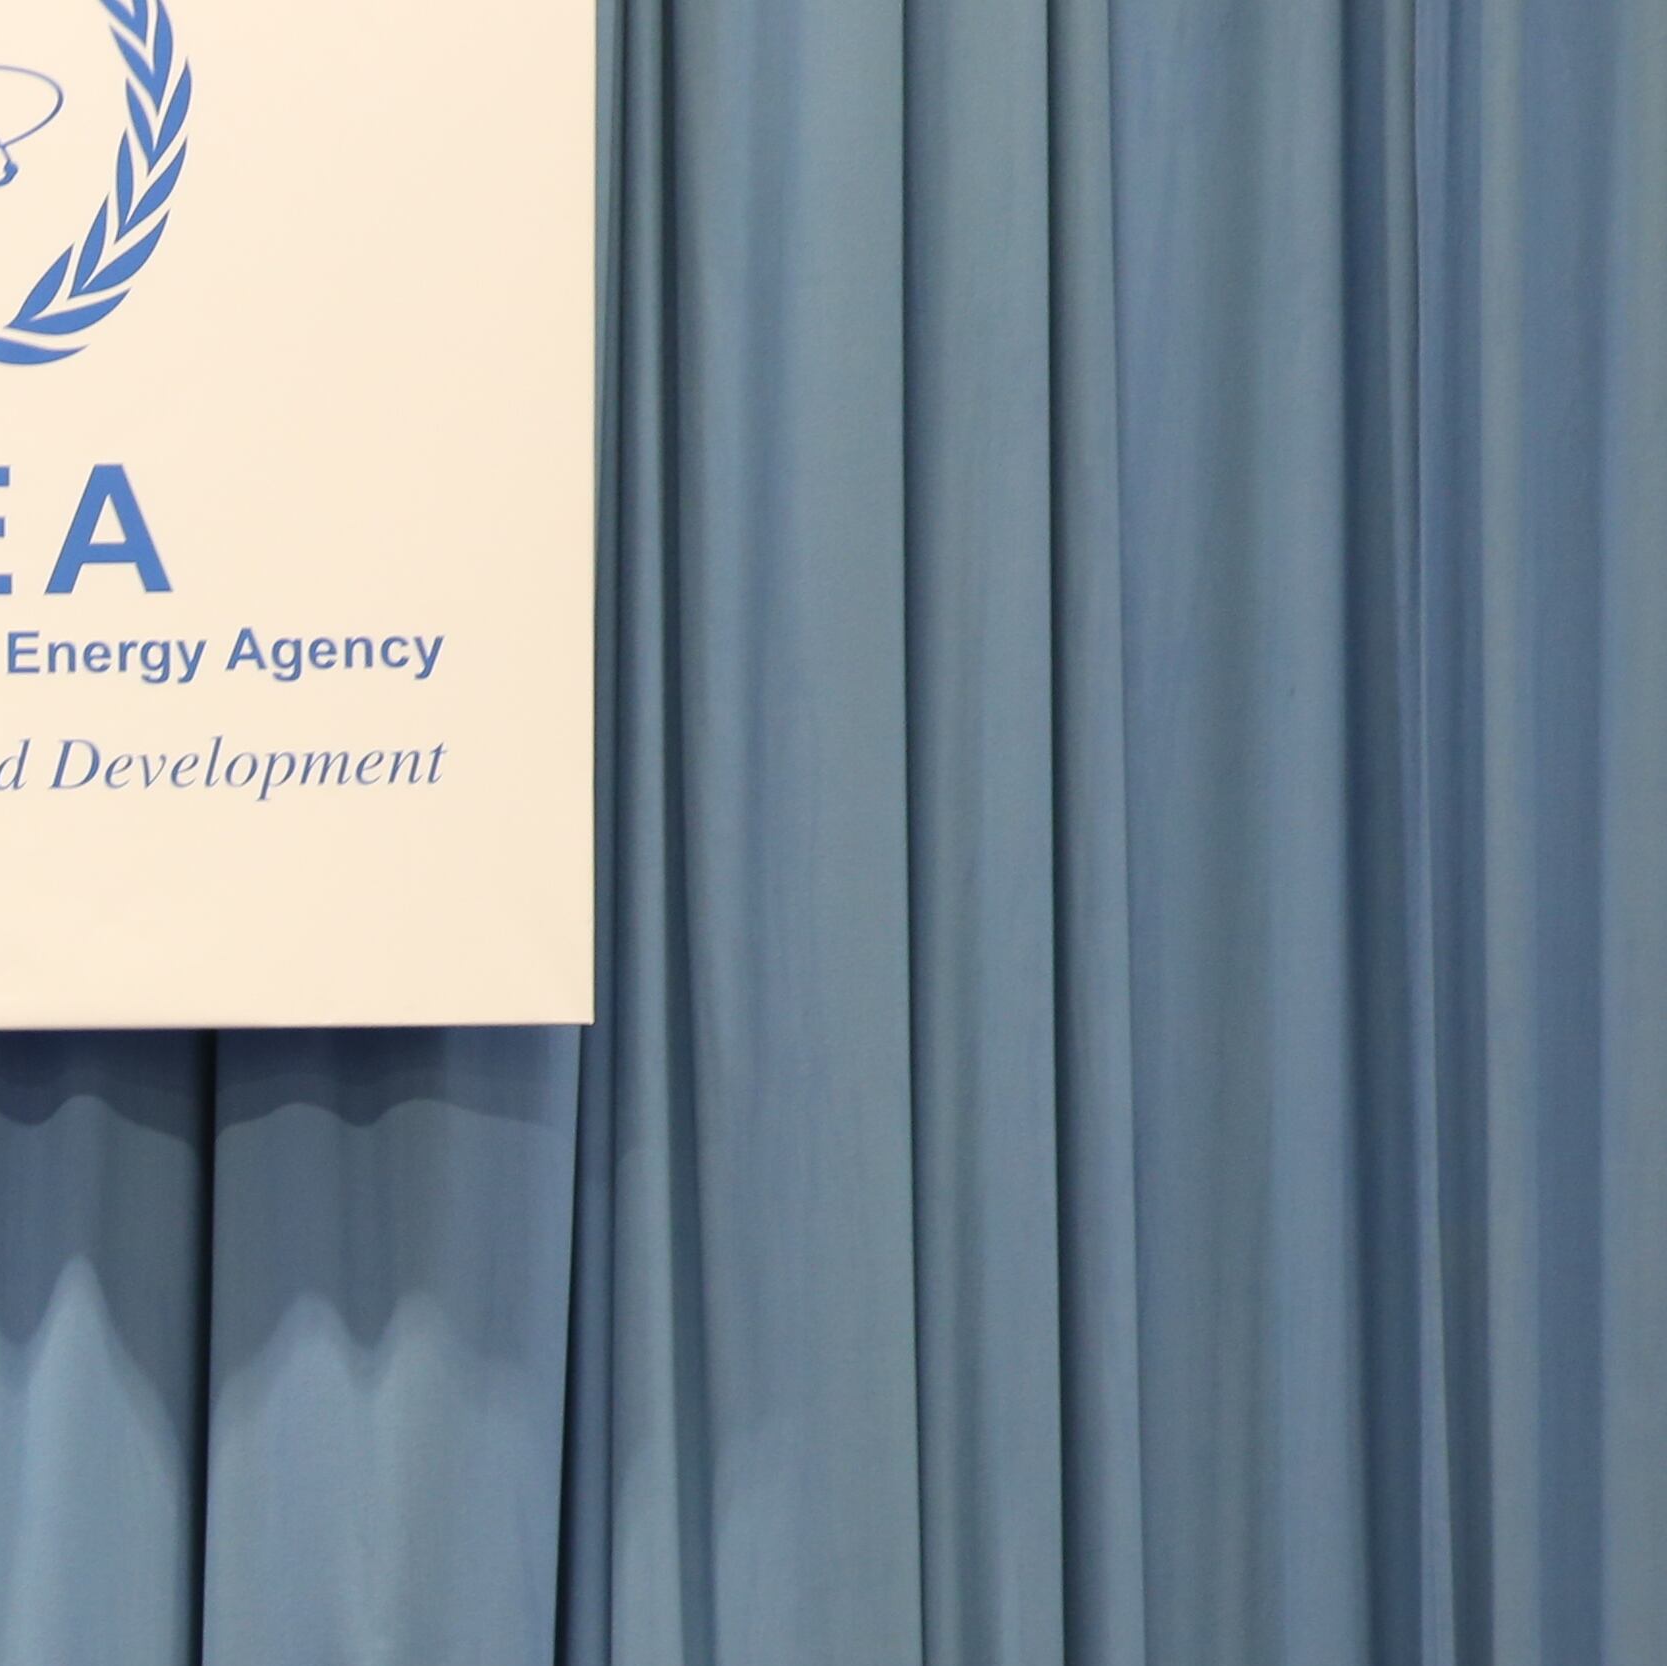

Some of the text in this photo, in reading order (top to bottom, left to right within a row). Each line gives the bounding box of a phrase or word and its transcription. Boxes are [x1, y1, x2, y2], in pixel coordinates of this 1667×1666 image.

[6, 630, 207, 685] Energy
[225, 626, 445, 682] Agency
[47, 734, 450, 804] Development
